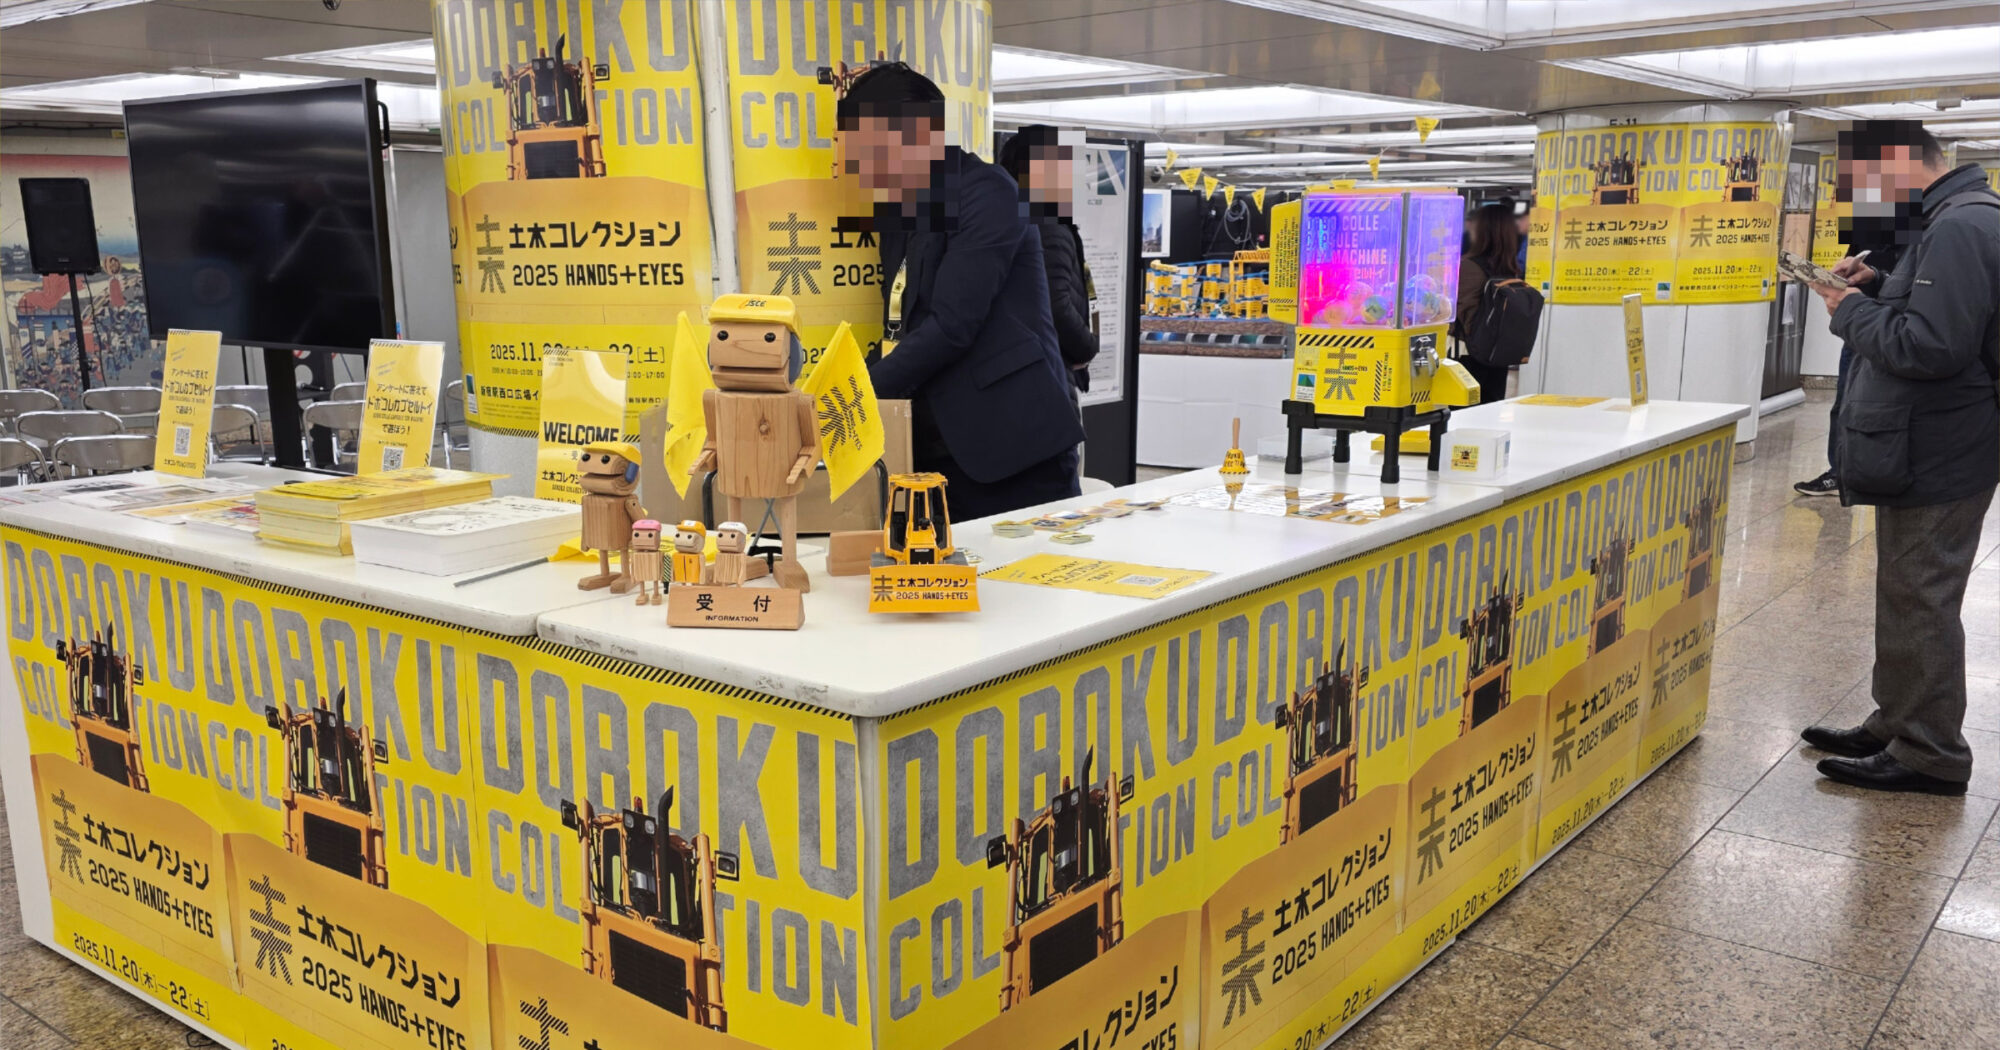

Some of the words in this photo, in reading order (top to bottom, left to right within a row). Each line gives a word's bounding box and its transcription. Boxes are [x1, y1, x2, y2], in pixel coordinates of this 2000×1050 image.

[1564, 129, 1683, 170] DOBOKU
[509, 220, 681, 249] 土木コレクション
[1342, 214, 1379, 231] COLLE
[1585, 219, 1668, 231] 土木コレクション
[1585, 236, 1610, 247] 2025
[1613, 235, 1667, 246] HANDS+EYES
[1716, 218, 1772, 229] 土木コレクション
[1716, 234, 1738, 244] 2025
[512, 264, 558, 287] 2025
[565, 263, 684, 286] HANDS+EYES
[1332, 249, 1387, 265] MACHINE
[376, 383, 428, 396] アンケートに答えて
[543, 421, 620, 446] WELCOME
[1560, 458, 1665, 582] DOBOKU
[896, 577, 969, 588] 土木コレクション
[896, 591, 920, 600] 2025
[922, 591, 969, 600] HANDS+EYES
[1422, 497, 1559, 650] DOBOKU
[5, 540, 196, 693] DOBOKU
[1214, 551, 1418, 746] DOBOKU
[201, 586, 462, 775] DOBOKU
[1579, 661, 1641, 725] 土木コレクション
[1577, 726, 1600, 760] 2025
[1600, 697, 1639, 742] HANDS+EYES
[476, 653, 858, 900] DOBOKU
[887, 629, 1200, 901] DOBOKU
[1450, 731, 1536, 814] 土木コレクション
[1449, 811, 1480, 853] 2025
[1482, 772, 1534, 830] HANDS+EYES
[83, 813, 210, 891] 土木コレクション
[1272, 827, 1391, 937] 土木コレクション
[88, 858, 130, 897] 2025
[133, 876, 214, 939] HANDS+EYES
[1272, 931, 1317, 985] 2025
[1321, 874, 1390, 952] HANDS+EYES
[297, 904, 461, 1009] 土木コレクション
[302, 955, 354, 1004] 2025
